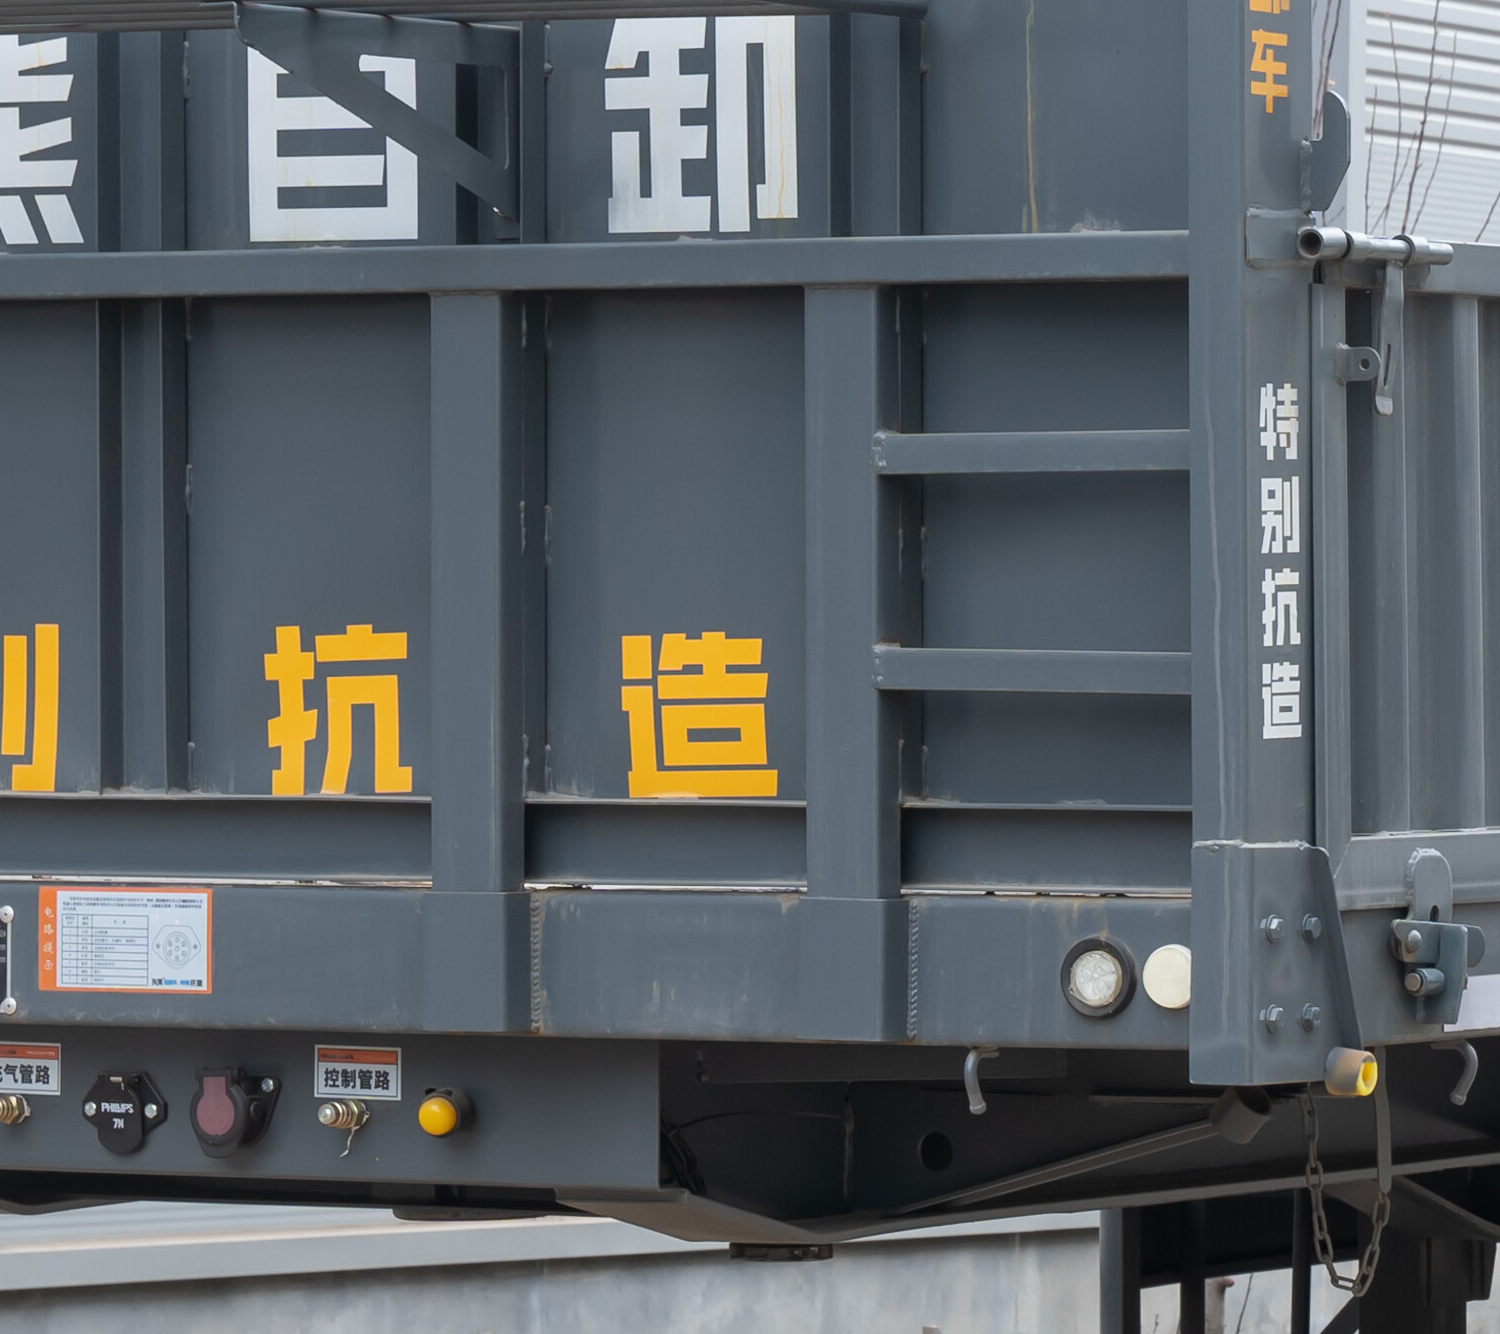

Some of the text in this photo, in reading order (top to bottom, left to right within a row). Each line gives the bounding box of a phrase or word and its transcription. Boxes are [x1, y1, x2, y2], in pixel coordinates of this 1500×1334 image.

[1260, 383, 1301, 740] 特别抗造
[324, 1068, 390, 1090] 控制管路
[112, 1118, 125, 1130] 7N
